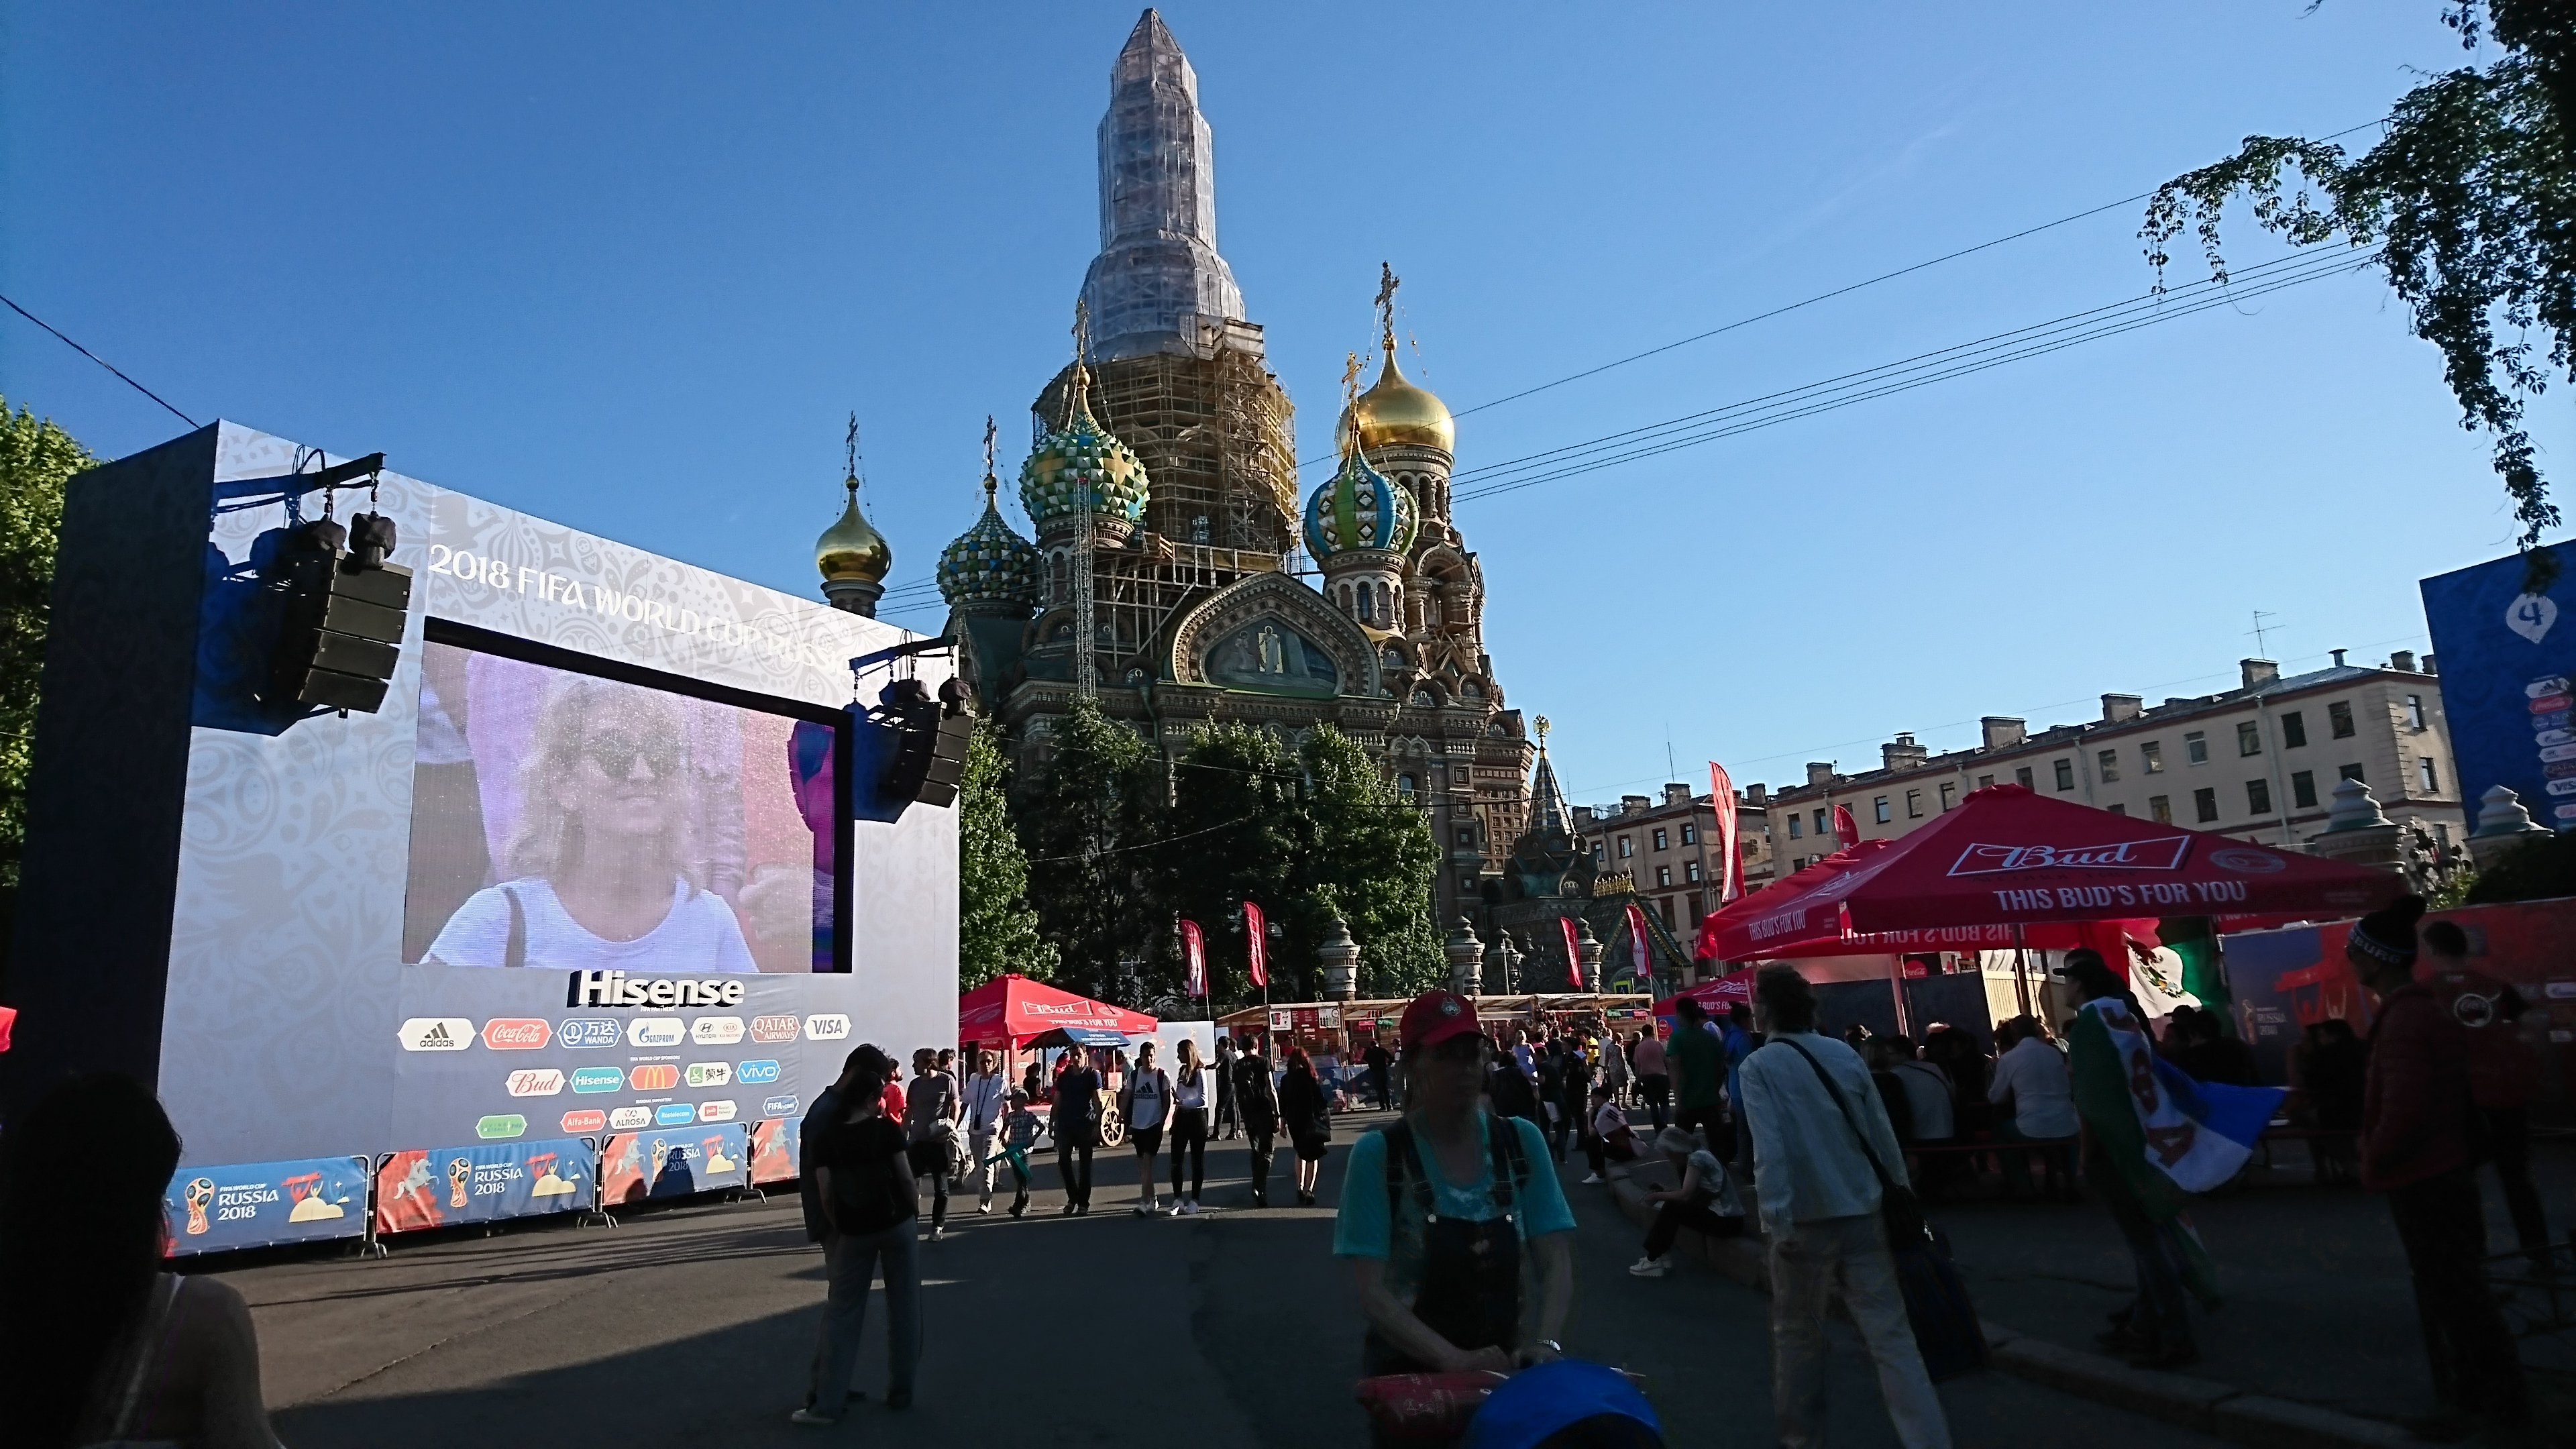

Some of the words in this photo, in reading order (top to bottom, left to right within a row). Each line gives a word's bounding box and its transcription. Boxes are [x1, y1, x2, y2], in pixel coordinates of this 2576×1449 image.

[428, 543, 510, 589] 2018
[518, 566, 587, 610] FIFA
[594, 586, 700, 635] WORLD
[706, 616, 761, 649] CUP
[767, 633, 854, 677] RUSSIA
[2518, 601, 2543, 626] 4
[1976, 843, 2138, 868] Bud
[1993, 888, 2054, 911] THIS
[2056, 885, 2136, 908] BUD'S
[2138, 882, 2191, 904] FOR
[2192, 880, 2246, 902] YOU
[1748, 920, 1762, 941] THIS
[1761, 915, 1780, 938] BUD'S
[1779, 912, 1793, 934] FOR
[1792, 908, 1807, 930] YOU
[578, 969, 745, 1006] Hisense
[1026, 1003, 1077, 1014] Bud
[1702, 1001, 1721, 1010] BUD'S
[584, 1021, 615, 1036] 万达
[754, 1017, 796, 1032] QATAR
[812, 1019, 843, 1034] VISA
[1104, 1018, 1118, 1027] YOU
[492, 1023, 543, 1043] Coca-Cola
[584, 1035, 614, 1044] WANDA
[649, 1034, 675, 1043] GAZPROM
[763, 1030, 796, 1040] AIRWAYS
[419, 1038, 454, 1047] adidas
[705, 1068, 726, 1081] 蒙牛
[741, 1065, 776, 1078] vivo
[512, 1073, 559, 1093] Bud
[576, 1075, 619, 1086] Hisense
[567, 1116, 601, 1126] Alfa-Bank
[661, 1111, 690, 1119] Rostelecom
[615, 1118, 646, 1127] ALROSA
[668, 1148, 700, 1161] RUSSIA
[668, 1161, 688, 1172] 2018
[474, 1168, 523, 1183] RUSSIA
[474, 1182, 505, 1195] 2018
[218, 1189, 279, 1206] RUSSIA
[217, 1205, 256, 1221] 2018
